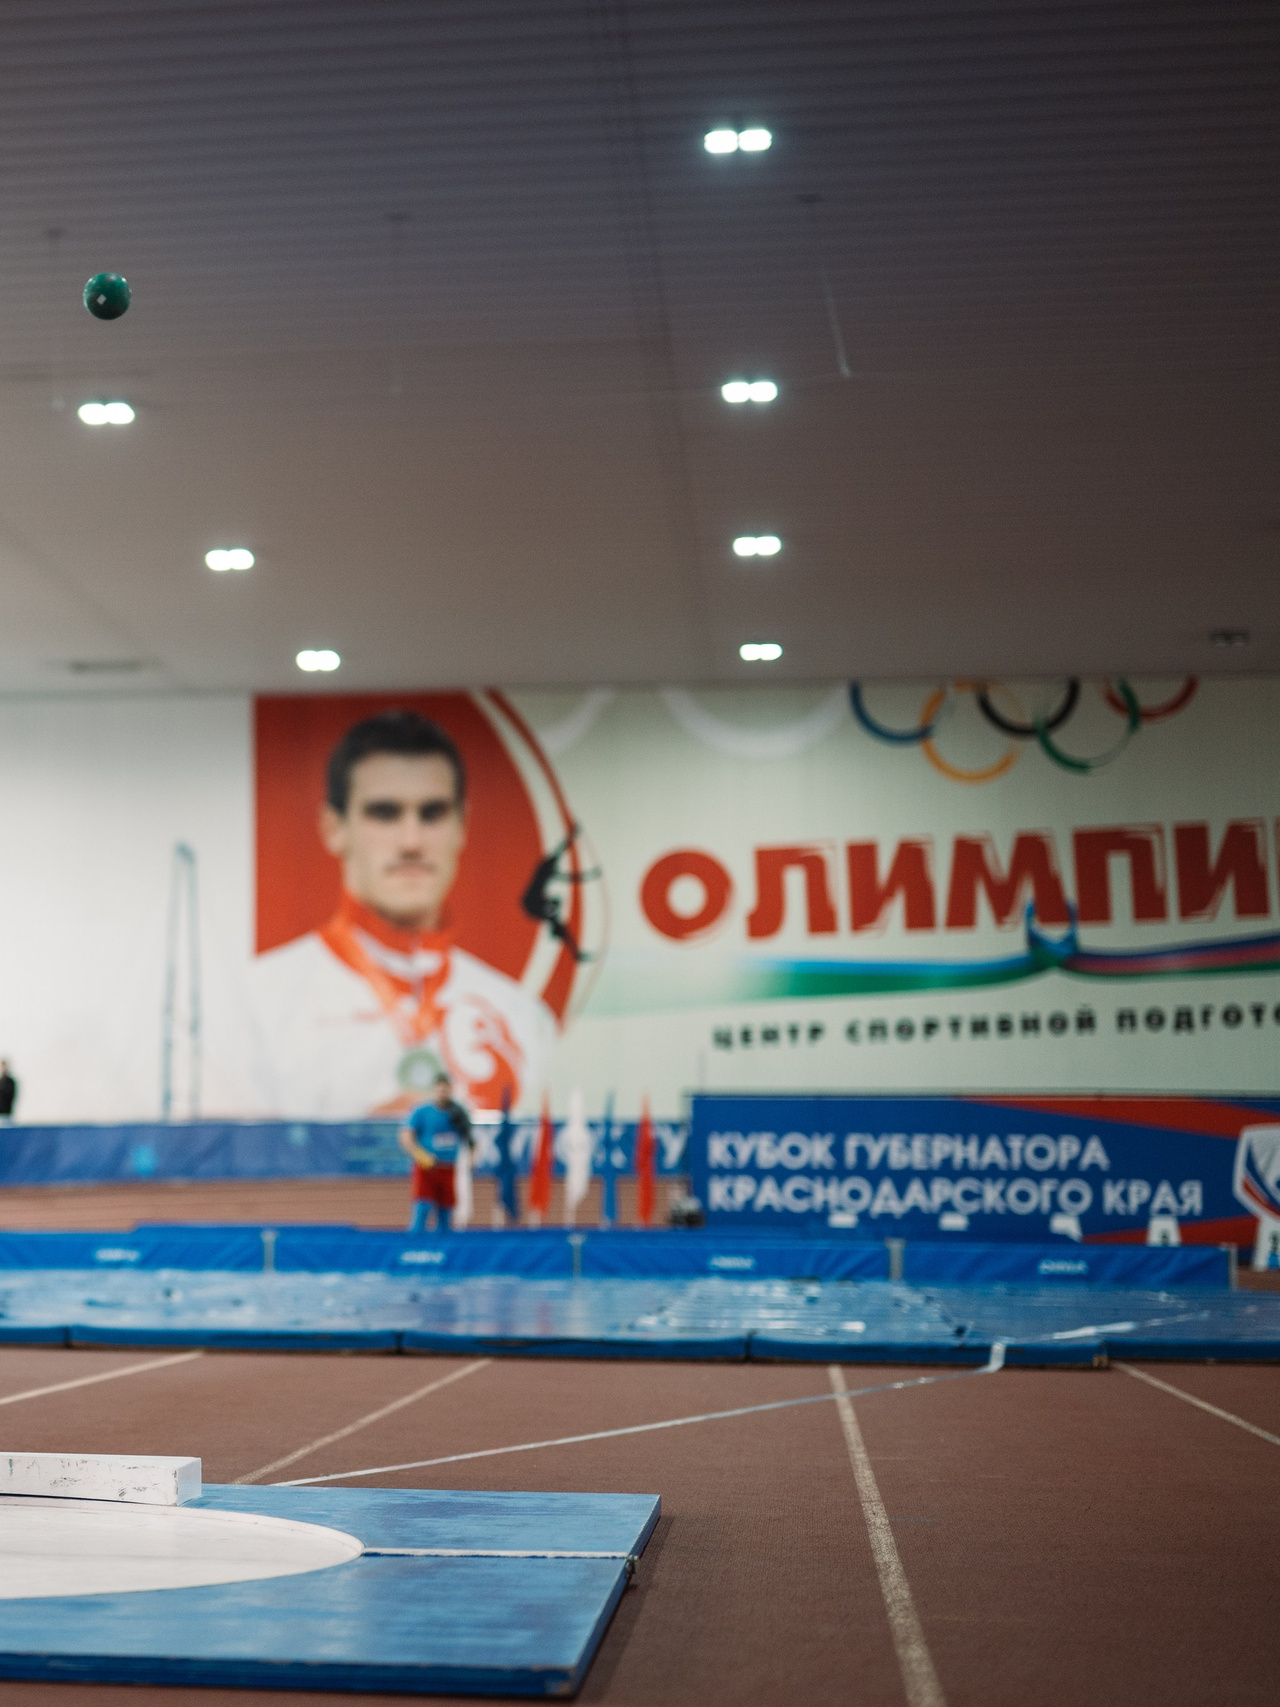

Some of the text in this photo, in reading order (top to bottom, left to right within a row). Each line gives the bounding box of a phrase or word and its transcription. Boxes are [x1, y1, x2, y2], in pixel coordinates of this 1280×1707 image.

[640, 818, 1280, 941] ОЛИМПИ
[713, 1025, 825, 1050] ЦЕНТР
[846, 1004, 1096, 1045] СПОРТИВНОЙ
[707, 1132, 835, 1170] КУБОК
[844, 1134, 1110, 1171] ГУБЕРНАТОРА
[708, 1175, 1203, 1219] КРАСНОДАРСКОГО КРАЯ
